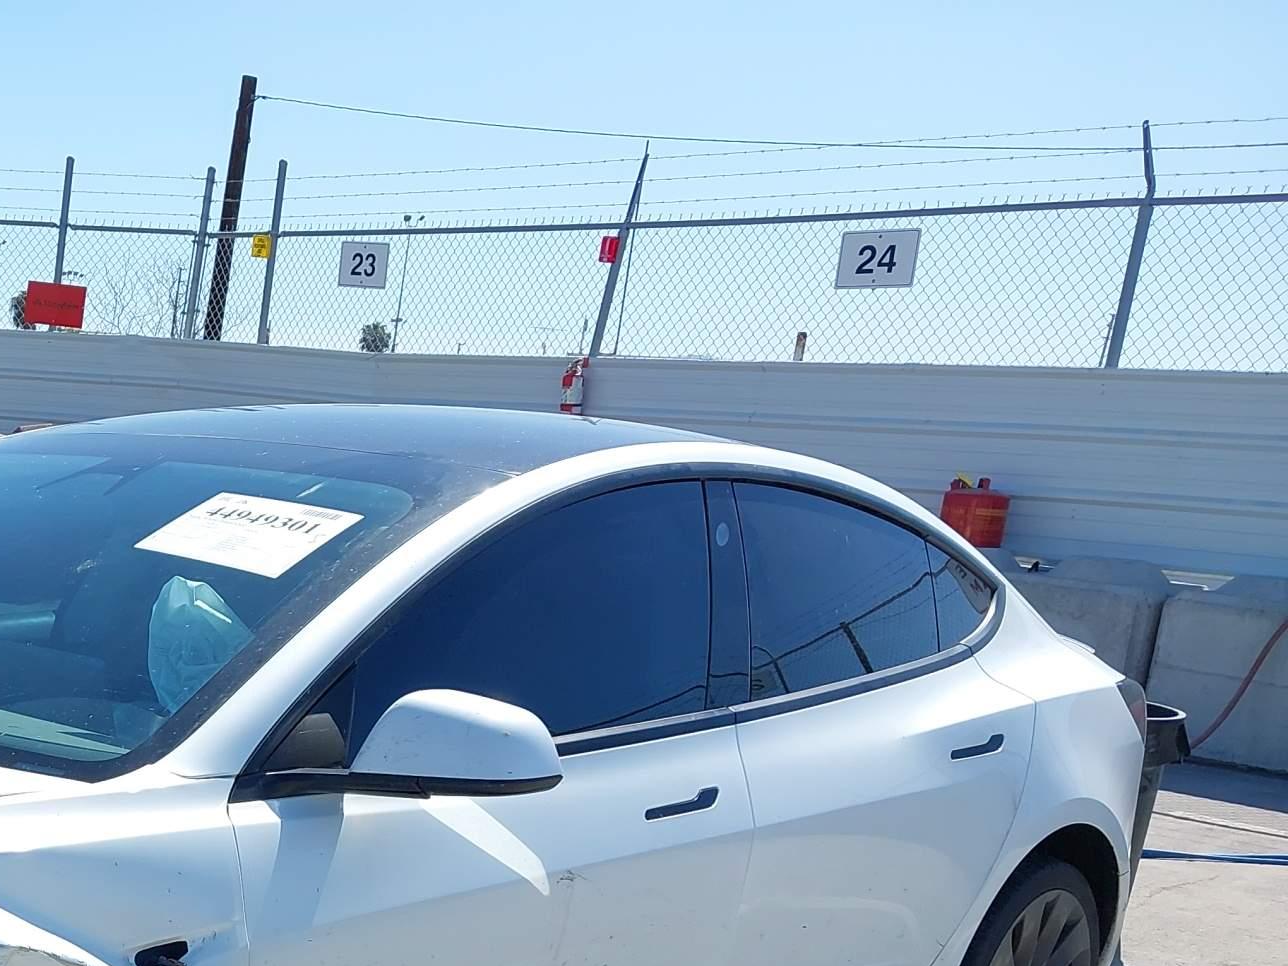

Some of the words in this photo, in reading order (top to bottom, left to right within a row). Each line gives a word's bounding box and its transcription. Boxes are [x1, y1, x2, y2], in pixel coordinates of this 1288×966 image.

[350, 252, 376, 277] 23
[856, 245, 897, 275] 24
[206, 506, 321, 534] 44949301
